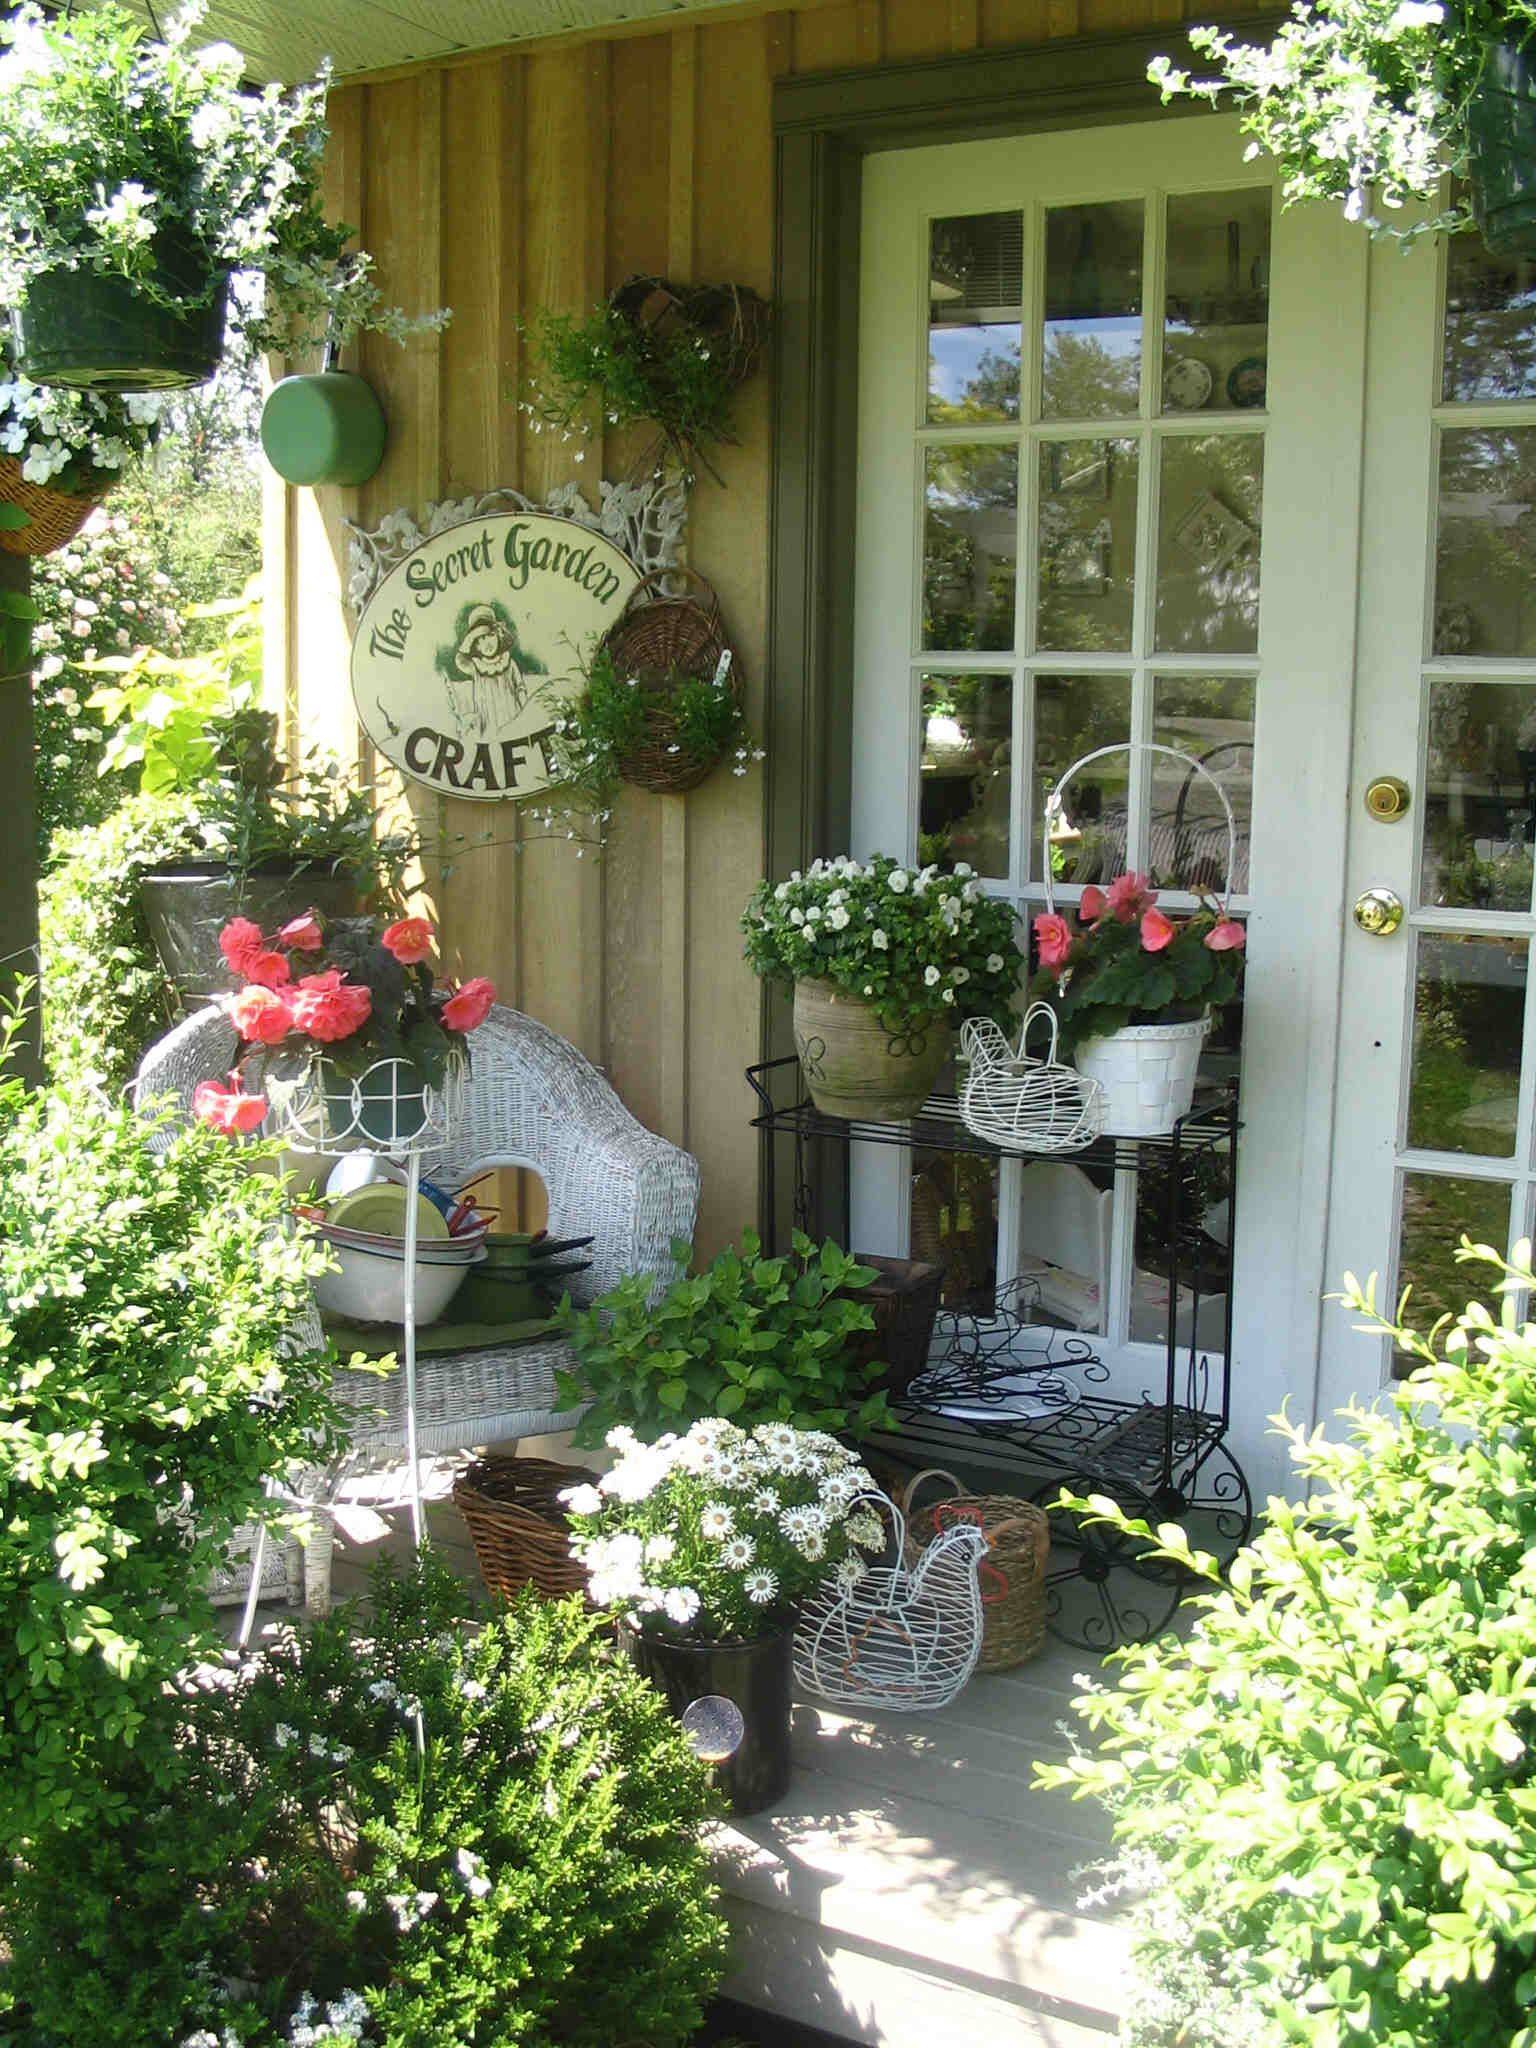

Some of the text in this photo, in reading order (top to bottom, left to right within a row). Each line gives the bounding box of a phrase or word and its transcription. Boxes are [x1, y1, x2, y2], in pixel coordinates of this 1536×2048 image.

[370, 523, 620, 661] The Secret Garden
[404, 727, 560, 790] CRAFT
